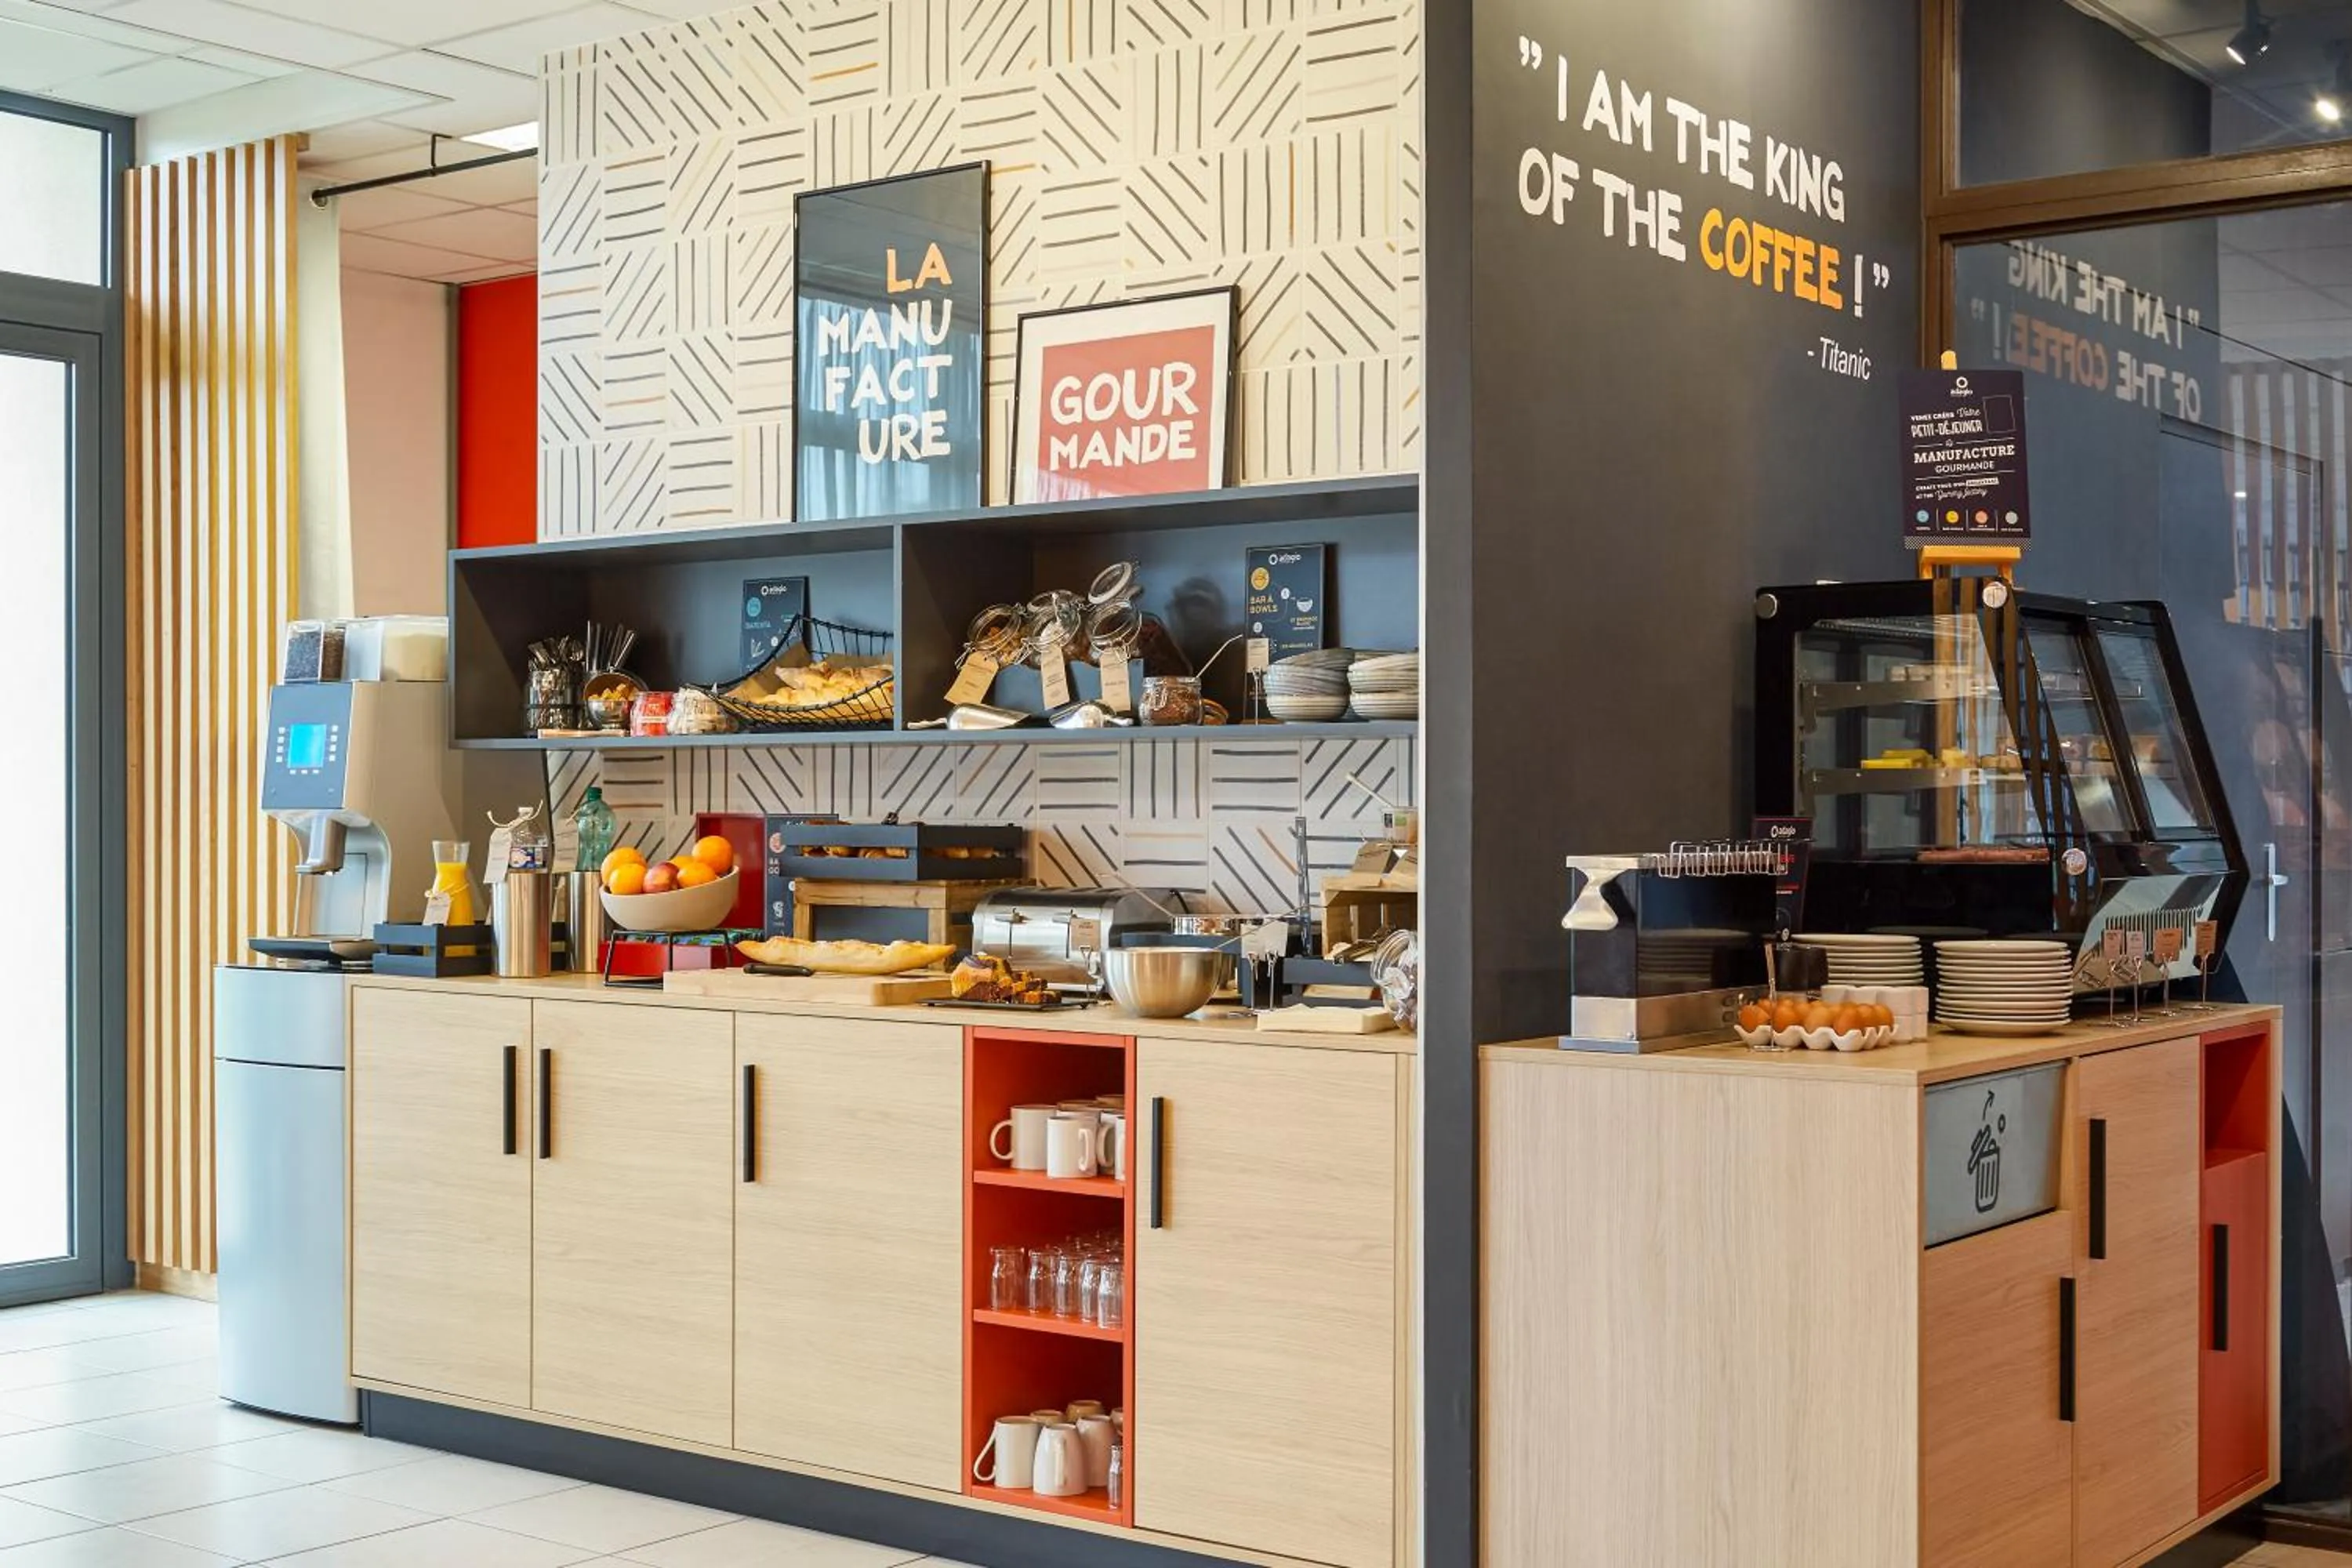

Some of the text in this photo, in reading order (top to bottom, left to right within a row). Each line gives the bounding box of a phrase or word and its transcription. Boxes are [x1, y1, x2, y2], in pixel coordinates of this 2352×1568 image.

[1583, 70, 1652, 151] AM
[1667, 97, 1754, 189] THE
[1766, 136, 1844, 223] KING
[1519, 147, 1580, 224] OF
[1592, 169, 1686, 262] THE
[1700, 208, 1842, 309] COFFEE
[887, 242, 953, 293] LA
[818, 299, 953, 355] MANU
[825, 354, 953, 412] FACT
[1051, 361, 1200, 425] GOUR
[858, 410, 951, 465] URE
[1050, 420, 1196, 471] MANDE
[1914, 445, 2015, 464] MANUFACTURE
[1935, 461, 1995, 474] GOURMANDE
